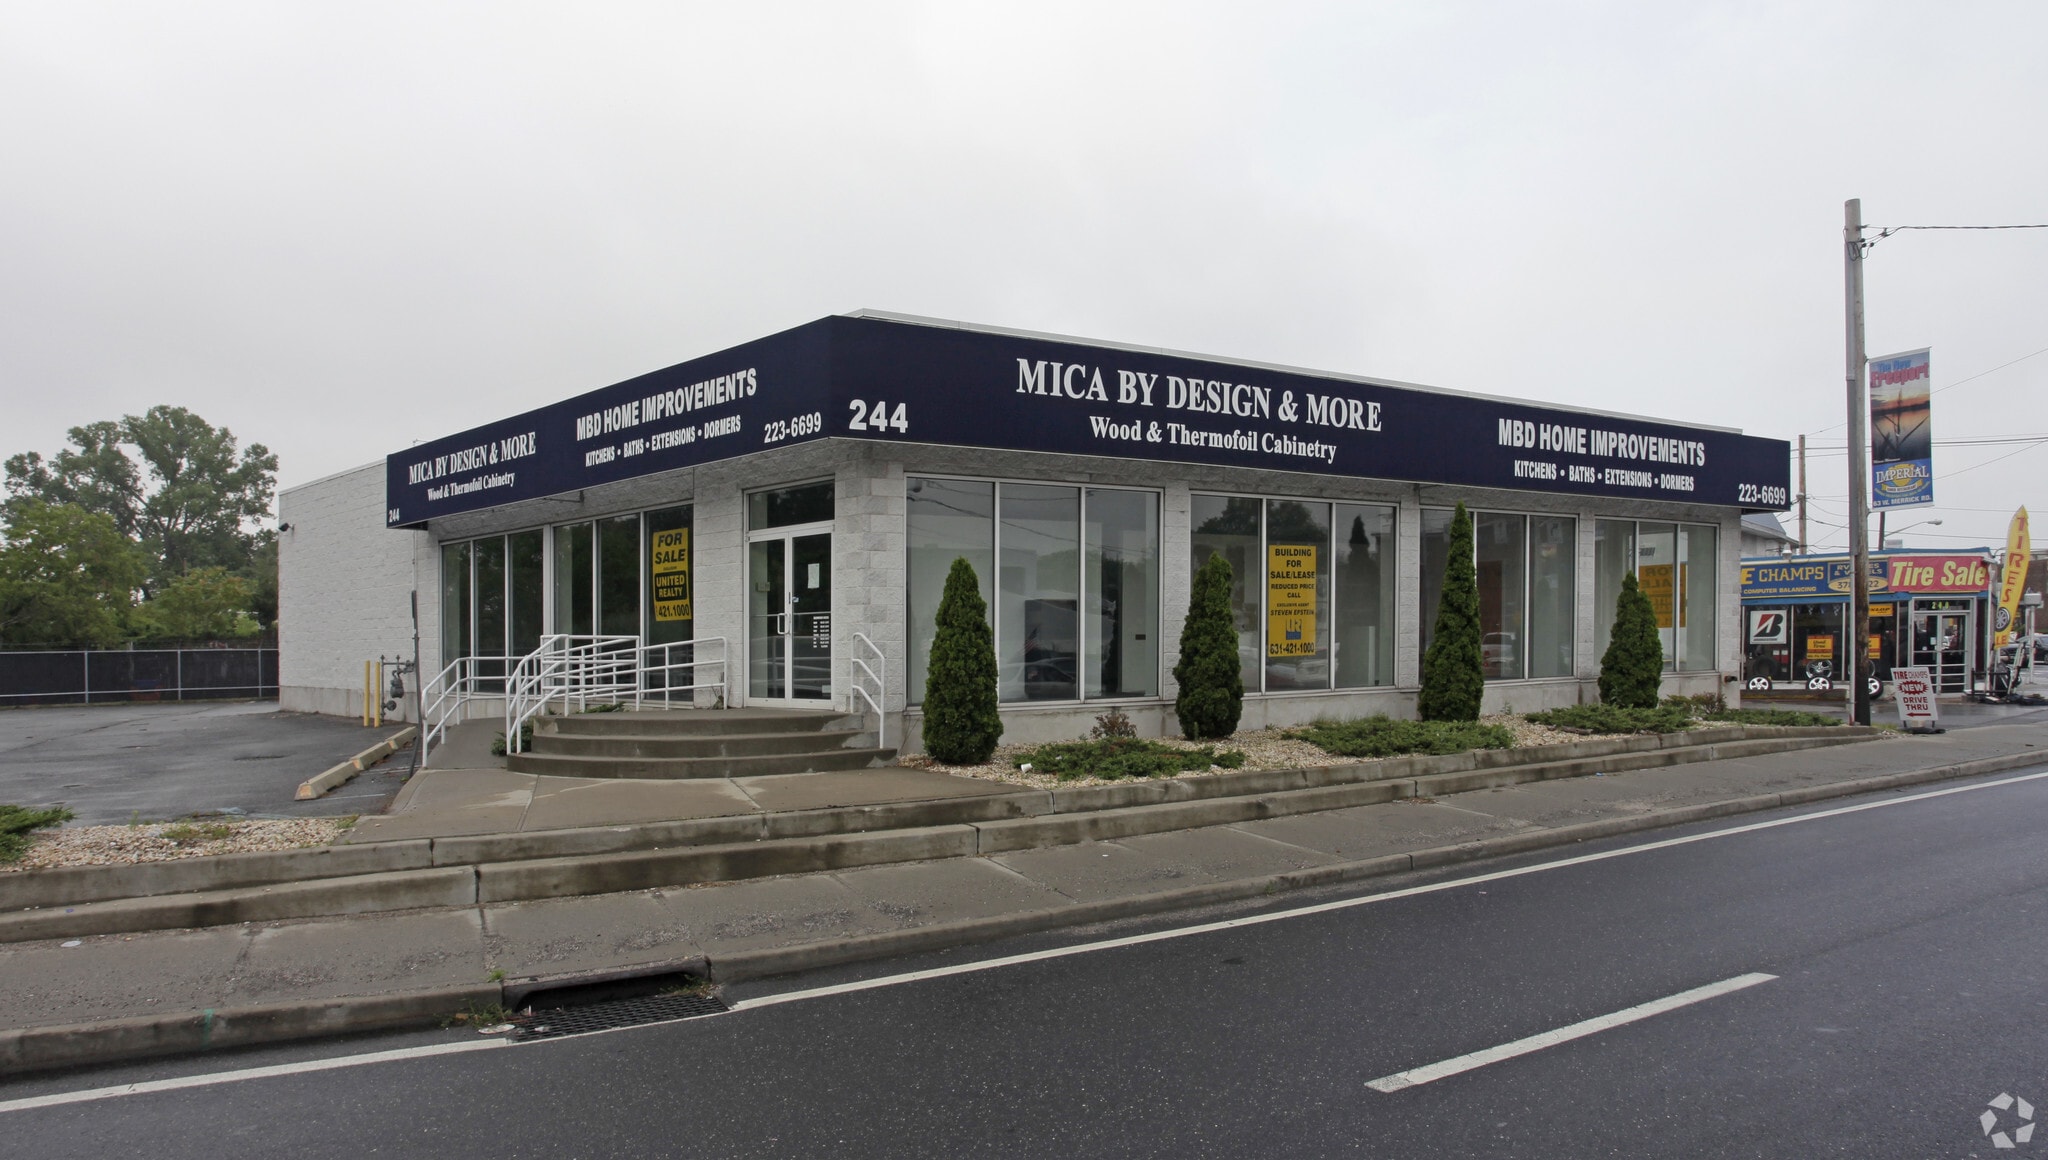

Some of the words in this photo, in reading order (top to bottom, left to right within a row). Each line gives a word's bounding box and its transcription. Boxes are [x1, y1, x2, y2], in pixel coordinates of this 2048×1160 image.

[576, 412, 601, 441] MBD
[604, 400, 640, 431] HOME
[642, 368, 756, 423] IMPROVEMENTS
[1016, 358, 1108, 402] MICA
[1117, 369, 1158, 406] BY
[1166, 374, 1272, 420] DESIGN
[1278, 390, 1299, 422] &
[1306, 394, 1382, 432] MORE
[849, 399, 908, 433] 244
[764, 412, 822, 444] 223-6699
[586, 445, 615, 467] KITCHENS
[624, 440, 644, 458] BATHS
[652, 426, 696, 452] EXTENSIONS
[704, 414, 741, 440] DORMERS
[1089, 416, 1142, 443] Wood
[1146, 422, 1162, 444] &
[1167, 423, 1258, 452] Thermofoil
[1261, 432, 1337, 464] Cabinetry
[1498, 418, 1536, 449] MBD
[1540, 424, 1586, 455] HOME
[1590, 430, 1705, 467] IMPROVEMENTS
[409, 462, 433, 485] MICA
[435, 455, 449, 478] BY
[450, 444, 487, 474] DESIGN
[489, 442, 498, 464] &
[501, 432, 536, 462] MORE
[428, 486, 443, 501] Wood
[444, 484, 450, 498] &
[450, 476, 482, 496] Thermofoil
[483, 472, 515, 488] Cabinetry
[1514, 460, 1556, 480] KITCHENS
[1568, 465, 1595, 484] BATHS
[1605, 468, 1652, 488] EXTENSIONS
[1660, 473, 1694, 492] DORMERS
[1876, 466, 1929, 484] IMPERIAL
[1738, 484, 1786, 506] 223-6699
[1891, 496, 1920, 504] MERRICK
[388, 508, 400, 522] 244
[658, 532, 682, 547] FOR
[655, 549, 686, 564] SALE
[1275, 548, 1312, 556] BUILDING
[2003, 517, 2024, 602] TIRES
[656, 575, 685, 587] UNITED
[1758, 566, 1824, 582] CHAMPS
[1892, 562, 1934, 586] Tire
[1940, 561, 1986, 586] Sale
[658, 587, 683, 598] REALTY
[1270, 642, 1314, 654] 631-421-1000
[1893, 671, 1908, 680] TIRE
